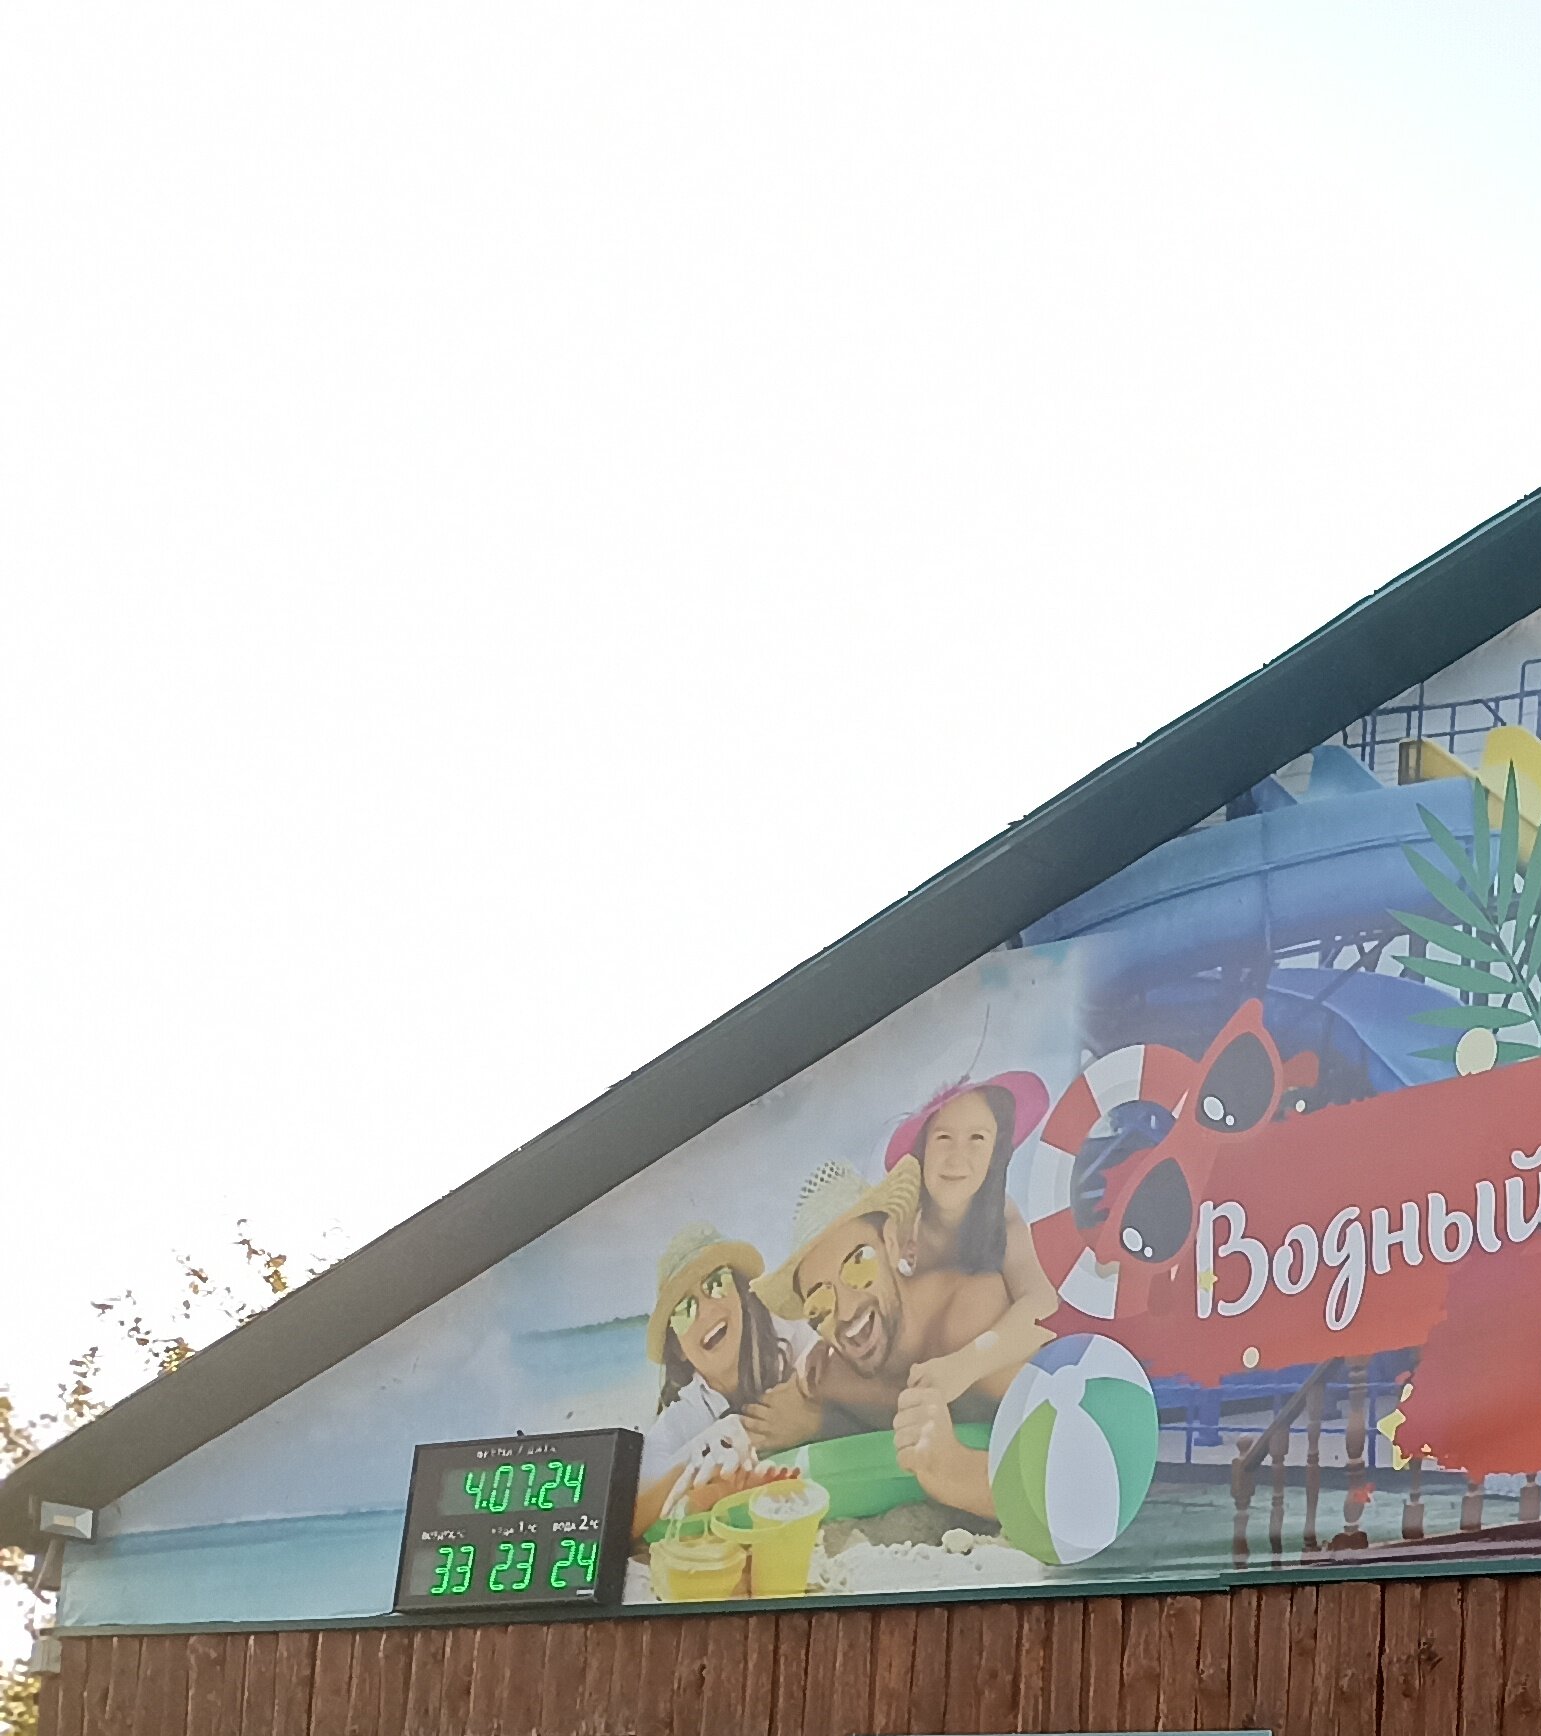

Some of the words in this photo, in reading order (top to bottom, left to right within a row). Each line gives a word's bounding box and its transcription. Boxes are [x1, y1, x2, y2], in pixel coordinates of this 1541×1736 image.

[578, 1515, 589, 1530] 2
[430, 1545, 475, 1595] 33
[489, 1541, 536, 1591] 23
[550, 1539, 598, 1588] 24
